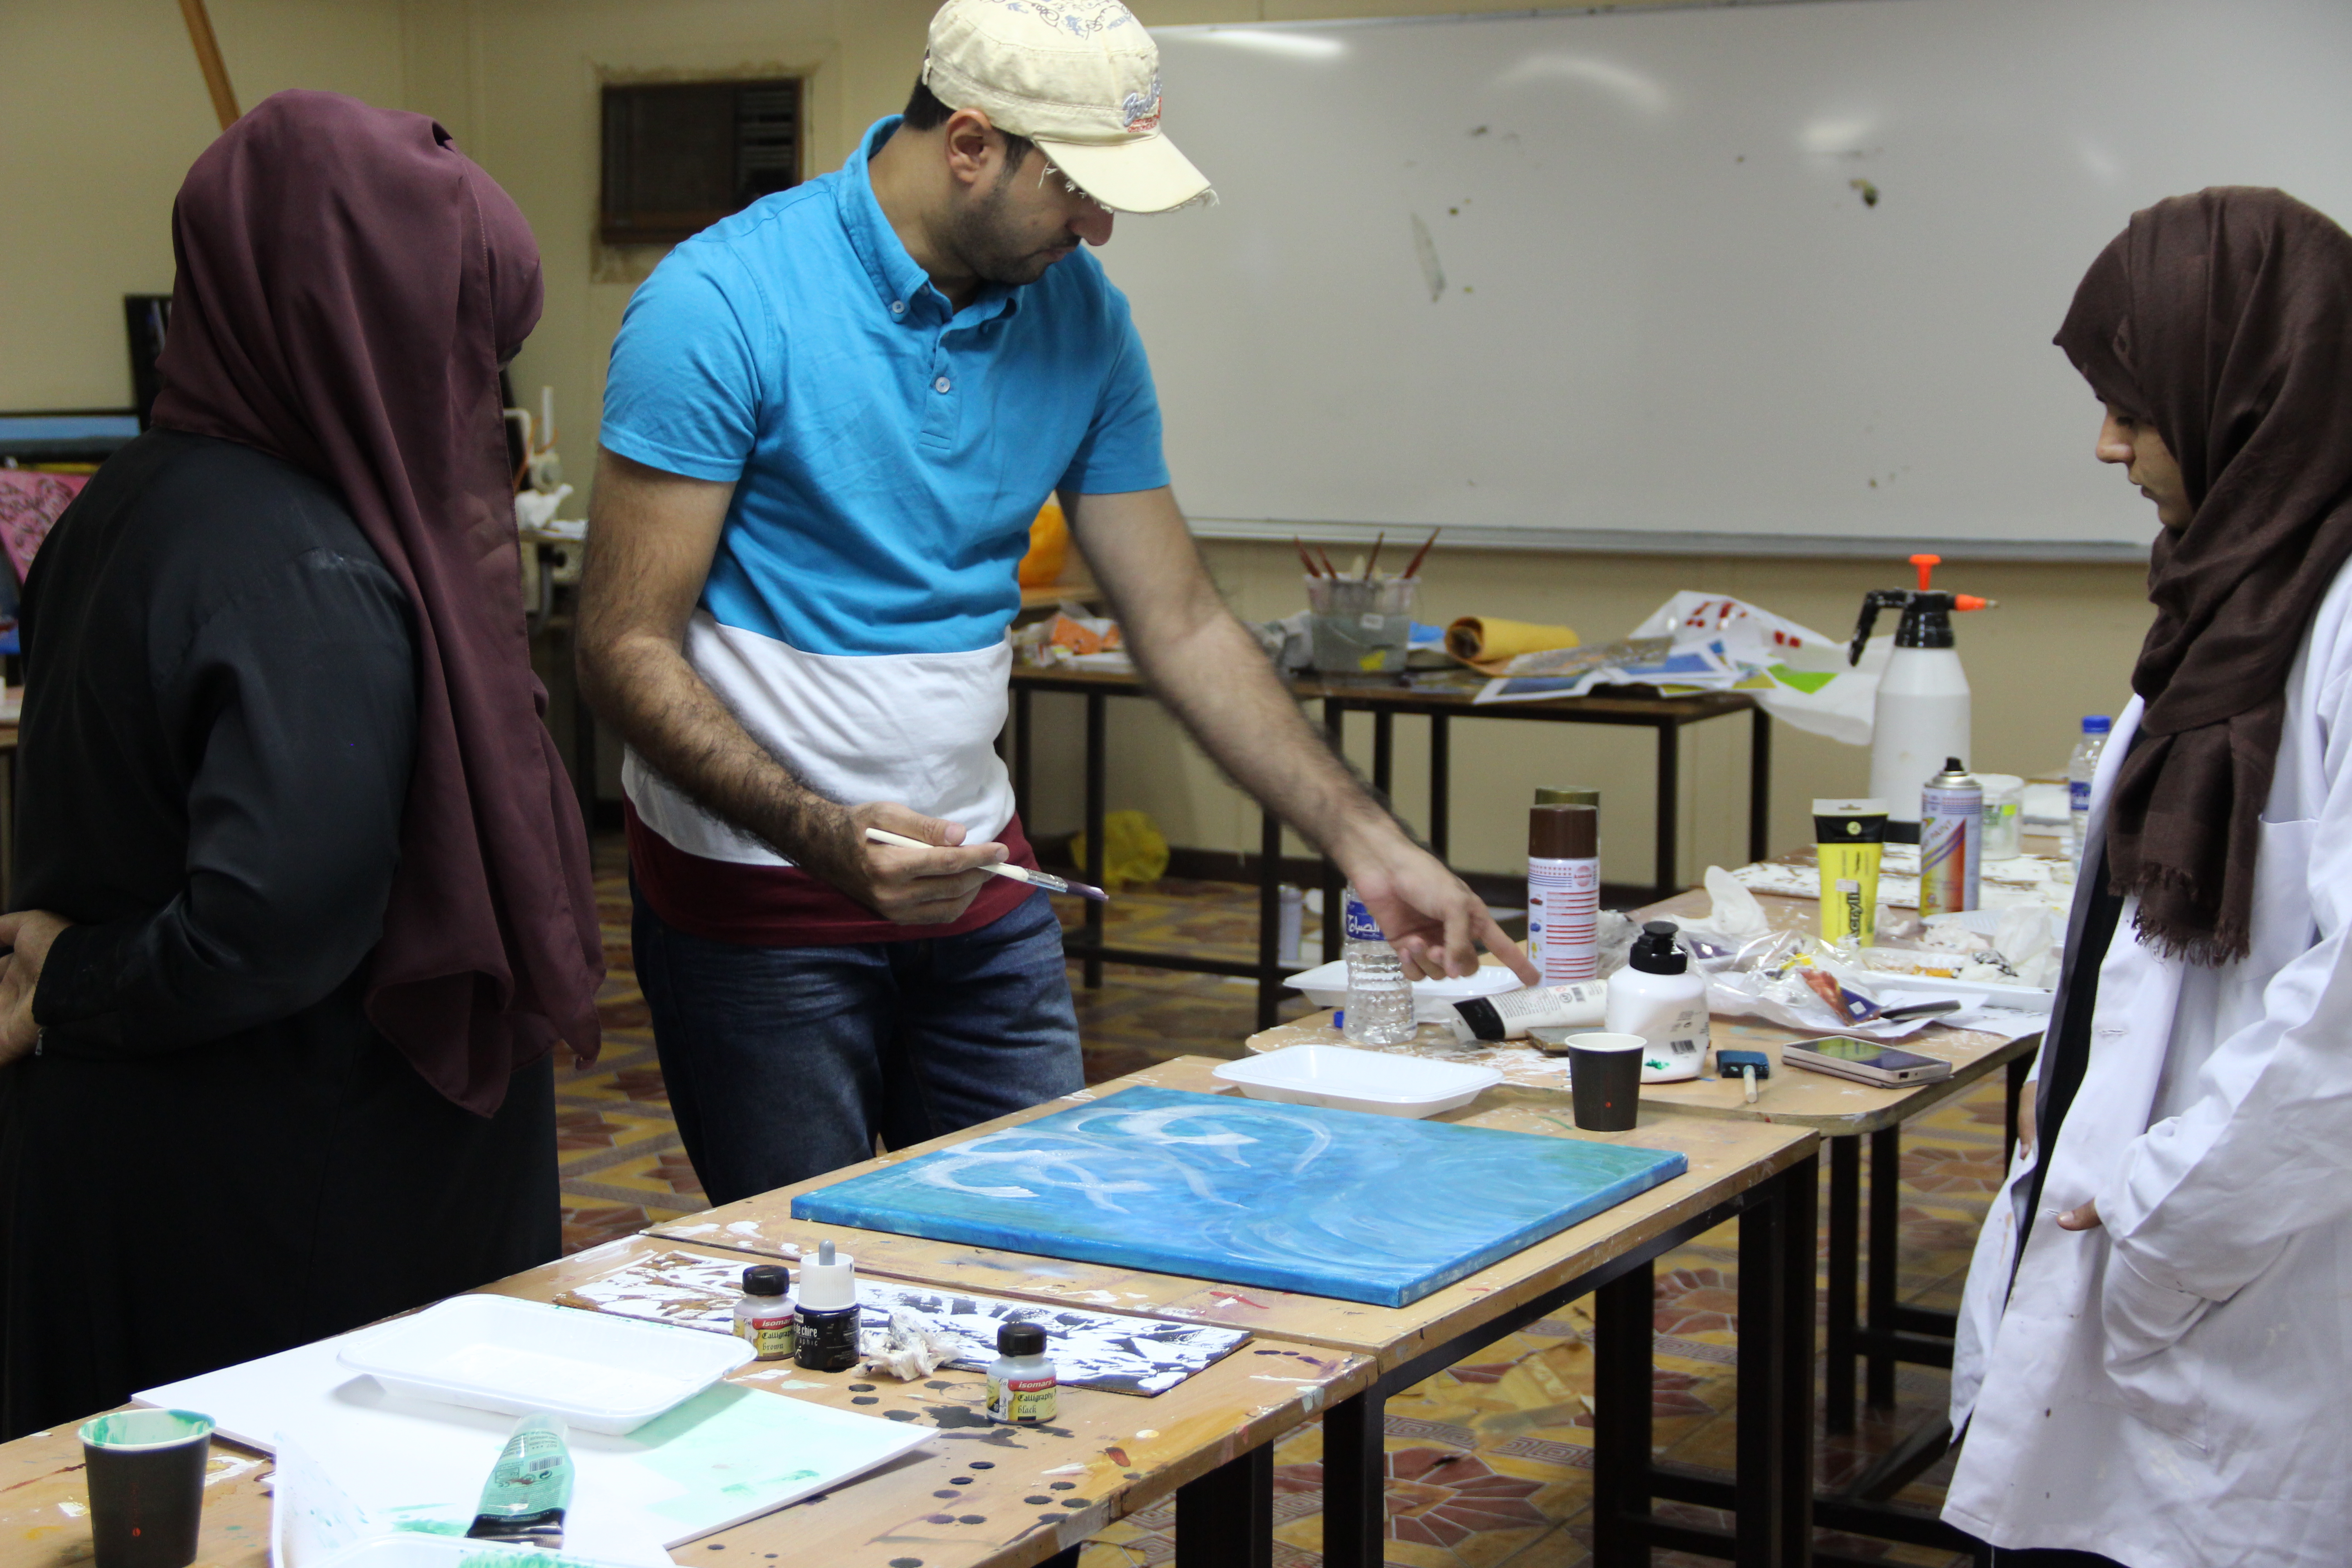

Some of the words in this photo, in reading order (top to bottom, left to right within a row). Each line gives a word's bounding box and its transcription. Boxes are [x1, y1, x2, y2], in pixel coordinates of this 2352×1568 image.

[762, 1342, 784, 1350] brown
[1019, 1379, 1052, 1388] isomars
[1018, 1392, 1054, 1402] Calligraphy
[1018, 1405, 1036, 1413] black
